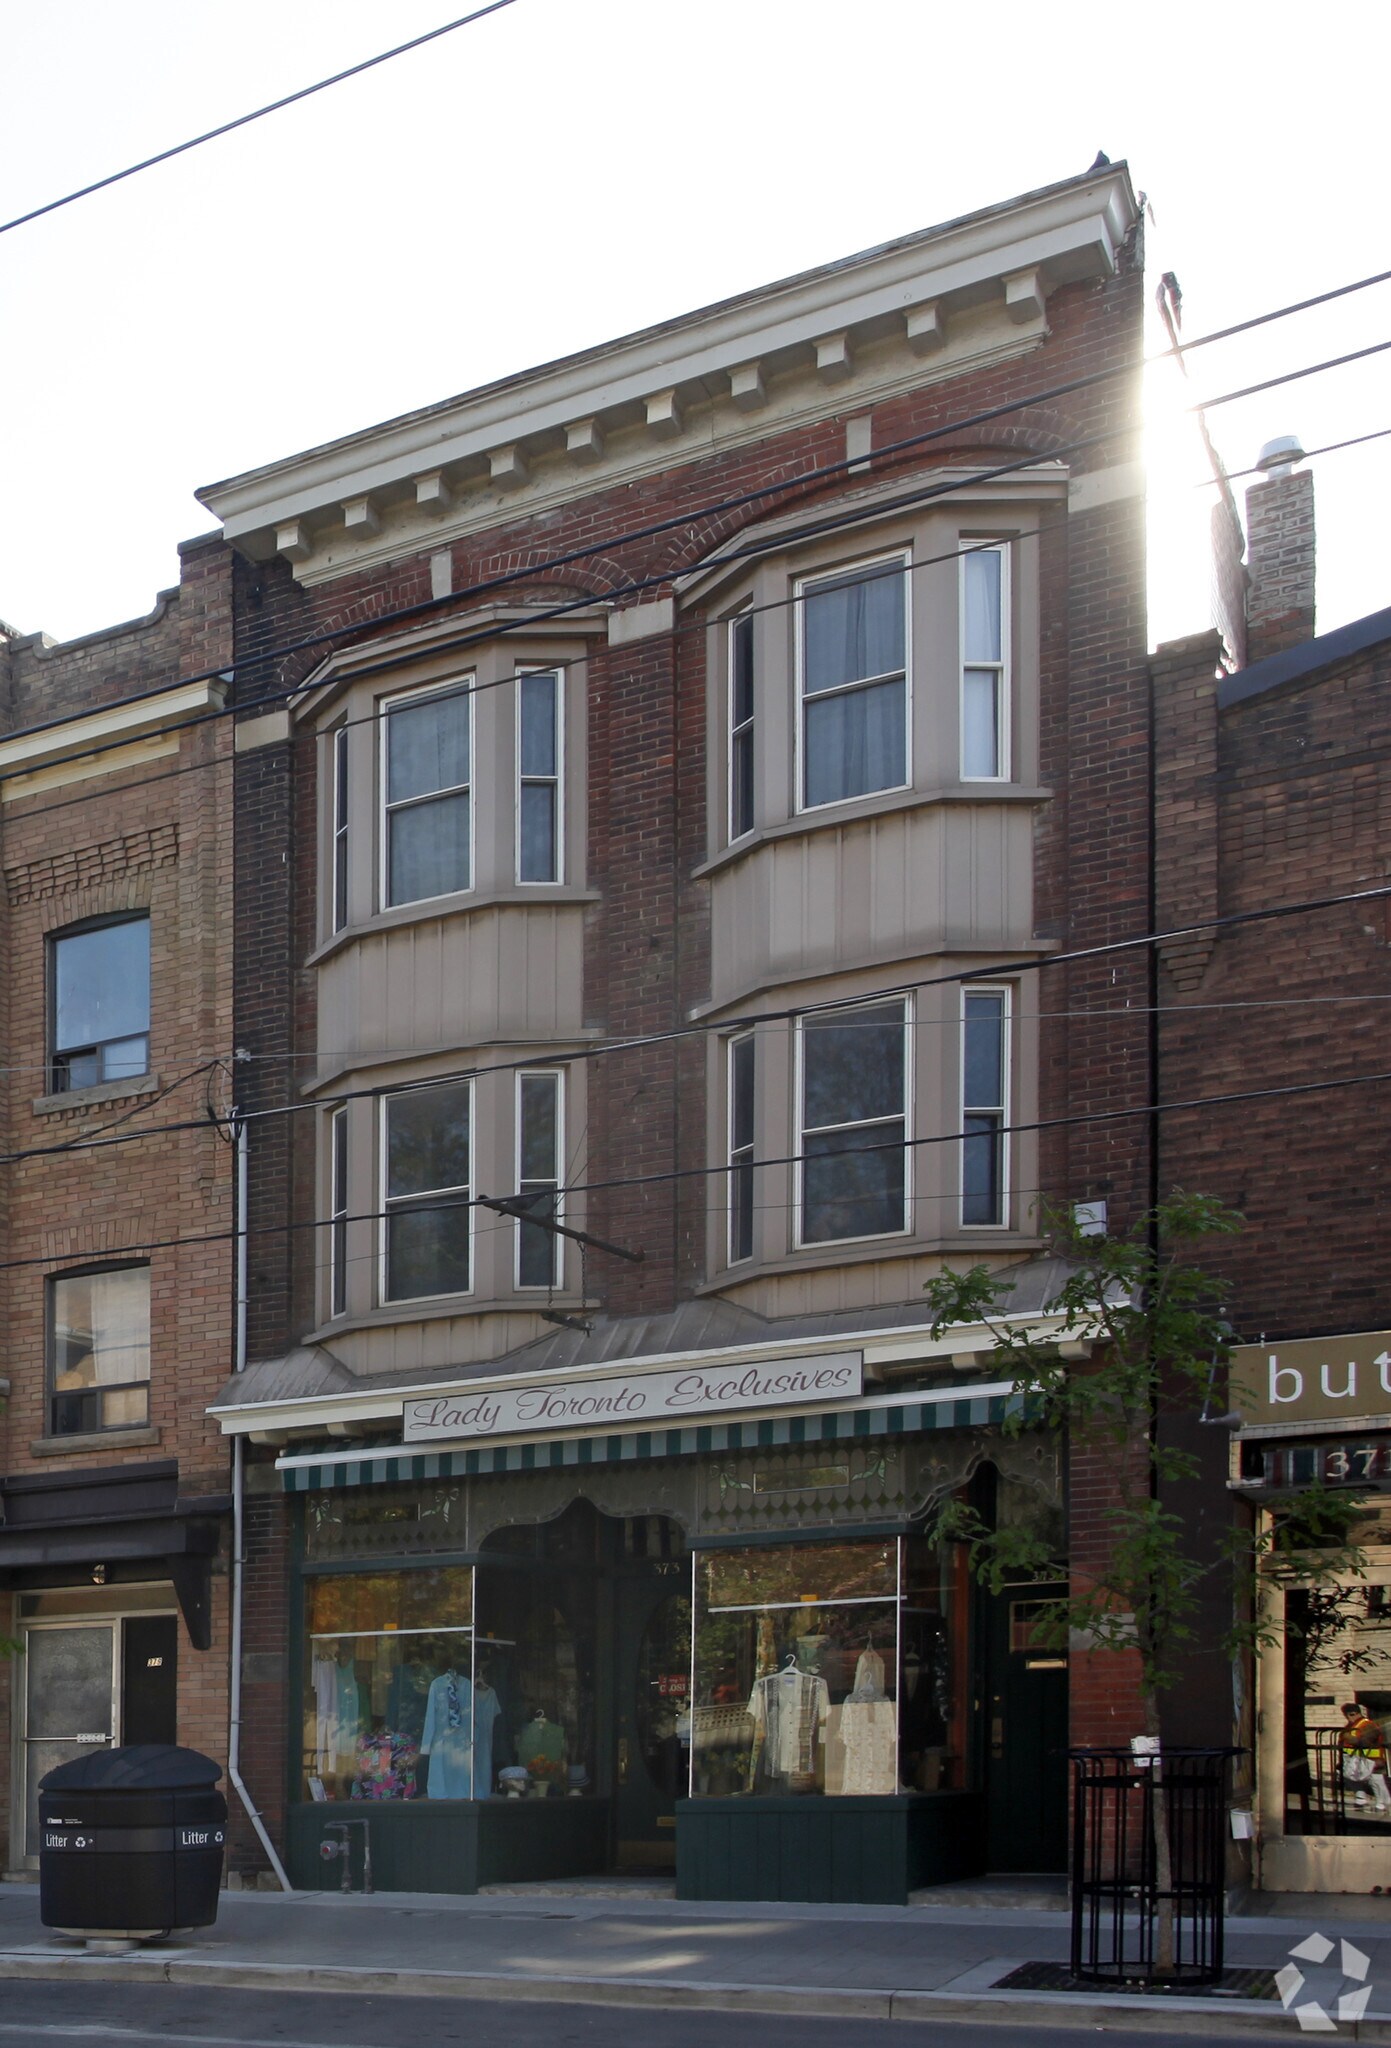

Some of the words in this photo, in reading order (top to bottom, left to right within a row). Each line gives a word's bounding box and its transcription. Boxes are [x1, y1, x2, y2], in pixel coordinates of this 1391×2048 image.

[409, 1397, 501, 1432] Lady
[516, 1387, 646, 1420] Toronto
[665, 1368, 851, 1407] Exclusives
[45, 1833, 68, 1847] Litter
[182, 1831, 208, 1845] Litter
